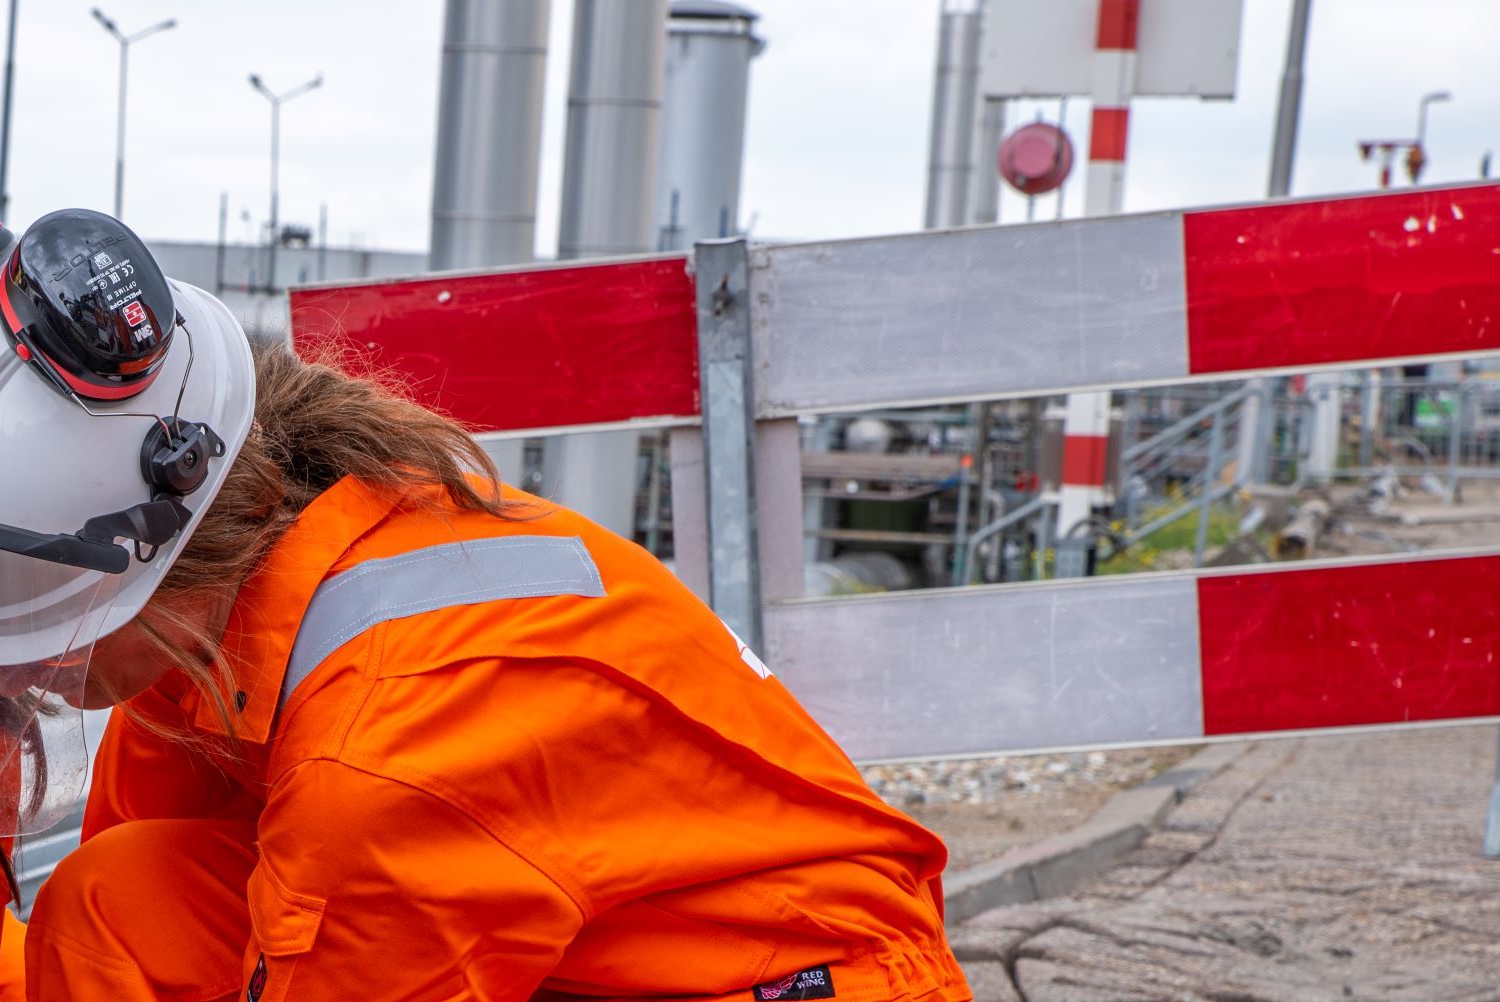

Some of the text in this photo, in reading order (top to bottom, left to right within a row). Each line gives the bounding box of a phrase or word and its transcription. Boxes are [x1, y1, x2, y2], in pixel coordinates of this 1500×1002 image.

[114, 280, 137, 298] OPTIME
[110, 289, 142, 311] PELTOR
[134, 324, 153, 342] 3M
[796, 978, 825, 989] WING
[802, 971, 823, 980] RED
